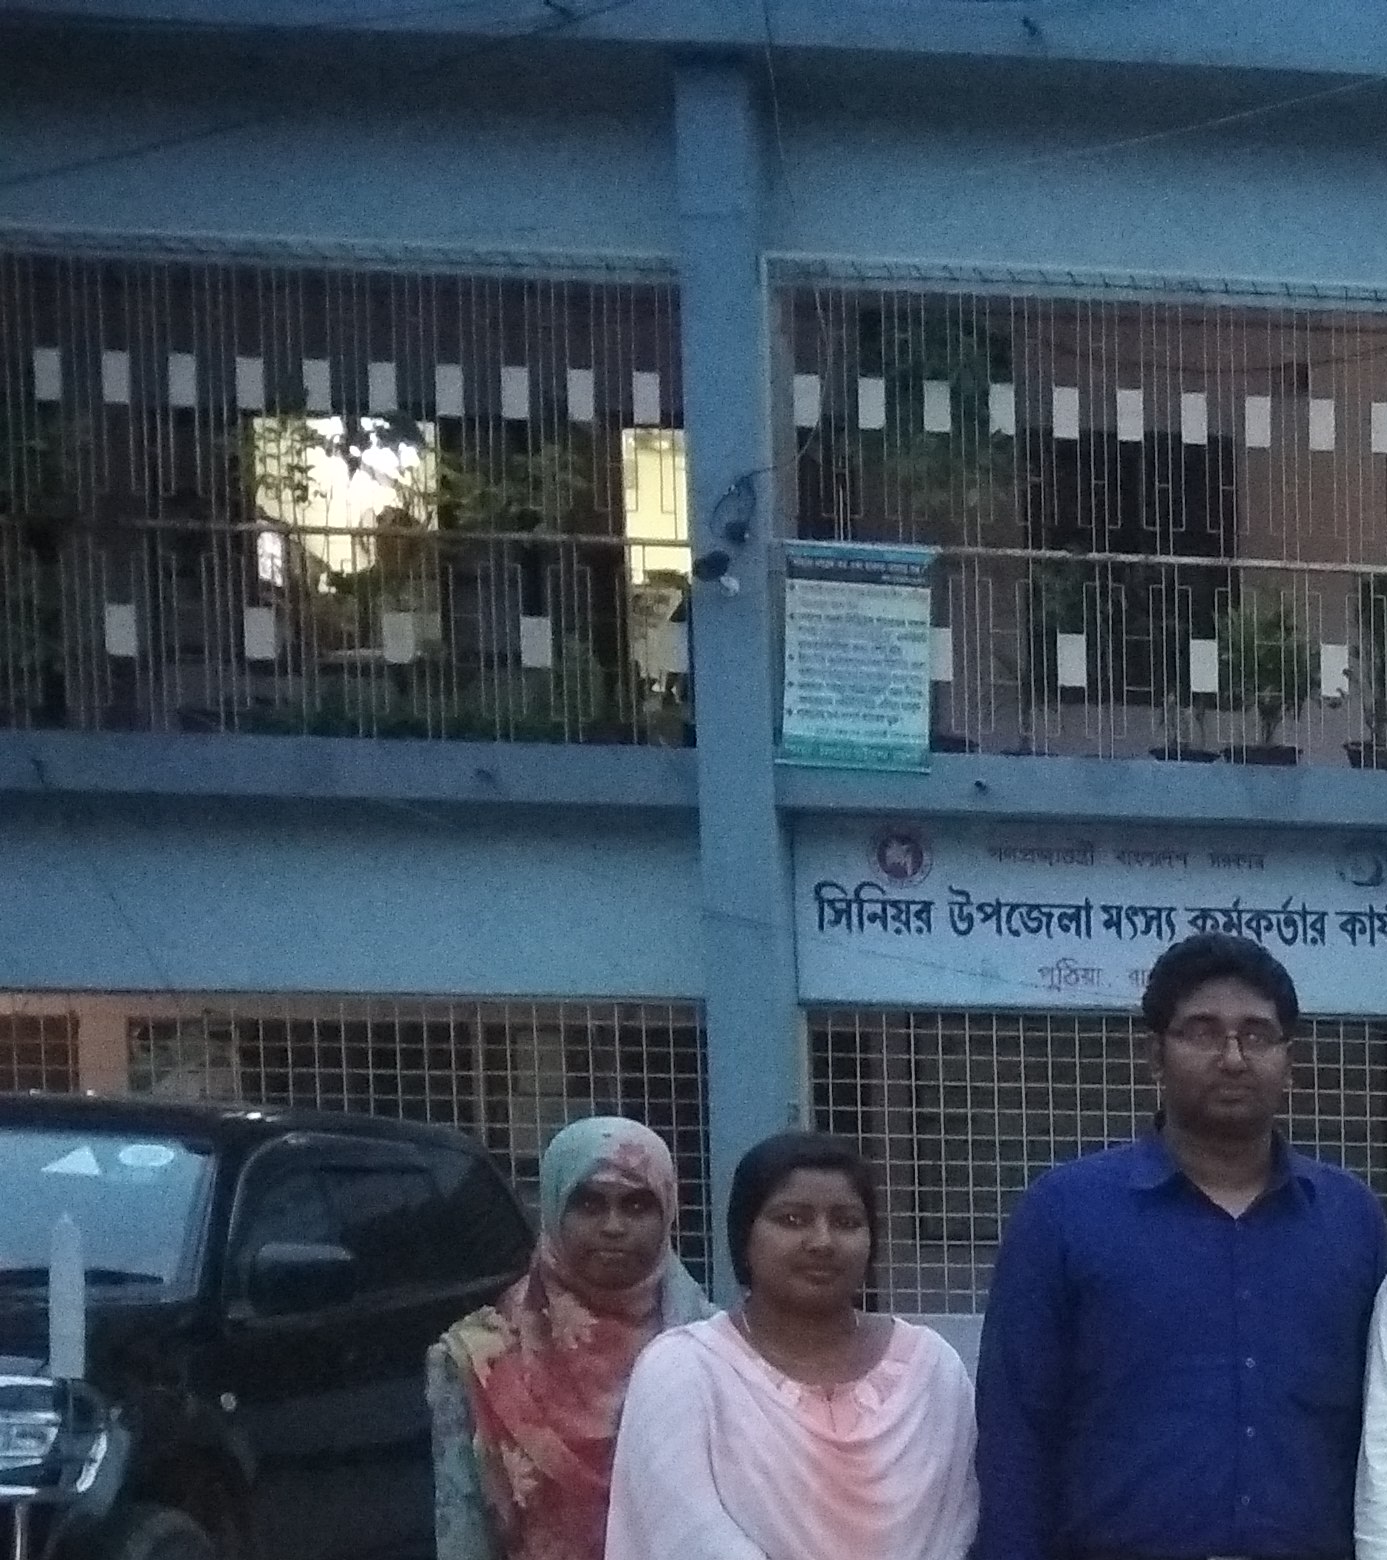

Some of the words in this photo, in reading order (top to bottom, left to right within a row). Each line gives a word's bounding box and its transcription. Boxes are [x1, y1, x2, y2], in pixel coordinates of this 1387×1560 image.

[814, 880, 936, 935] সিনিয়র
[947, 884, 1093, 940] উপজেলা
[1100, 903, 1177, 943] মৎস্য
[1184, 896, 1329, 947] কর্মকর্তার
